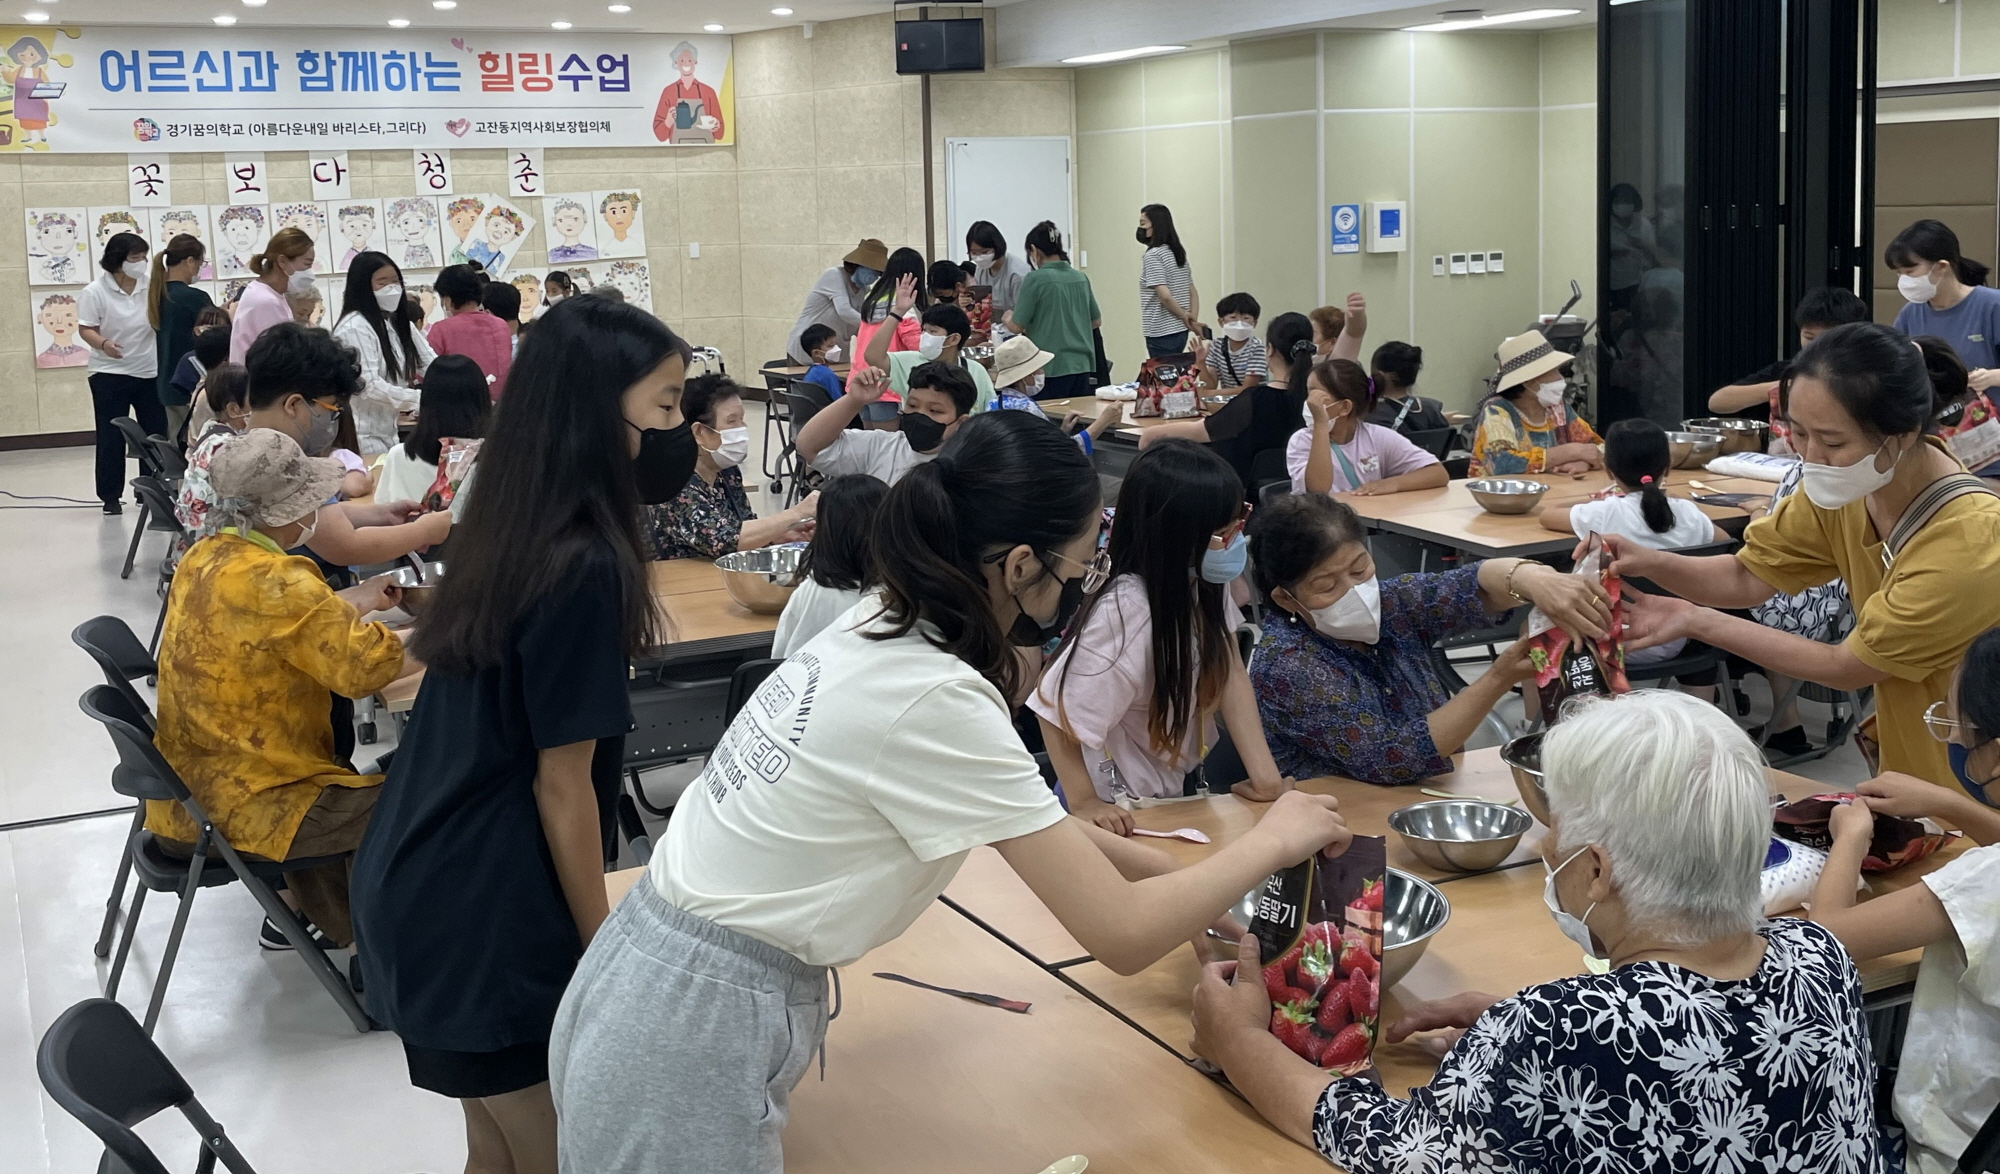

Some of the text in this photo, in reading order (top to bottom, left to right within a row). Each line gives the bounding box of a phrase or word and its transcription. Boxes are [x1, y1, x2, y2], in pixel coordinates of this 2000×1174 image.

[100, 49, 630, 93] 어르신과 함께하는 힐링수업
[166, 121, 427, 137] 경기꿈의학교 (아름다운내일 바리스타,그리다)
[475, 120, 611, 134] 고잔동지역사회보장협의체
[132, 152, 538, 197] 꽃 보 다 청 춘
[788, 666, 821, 747] COMMUNITY
